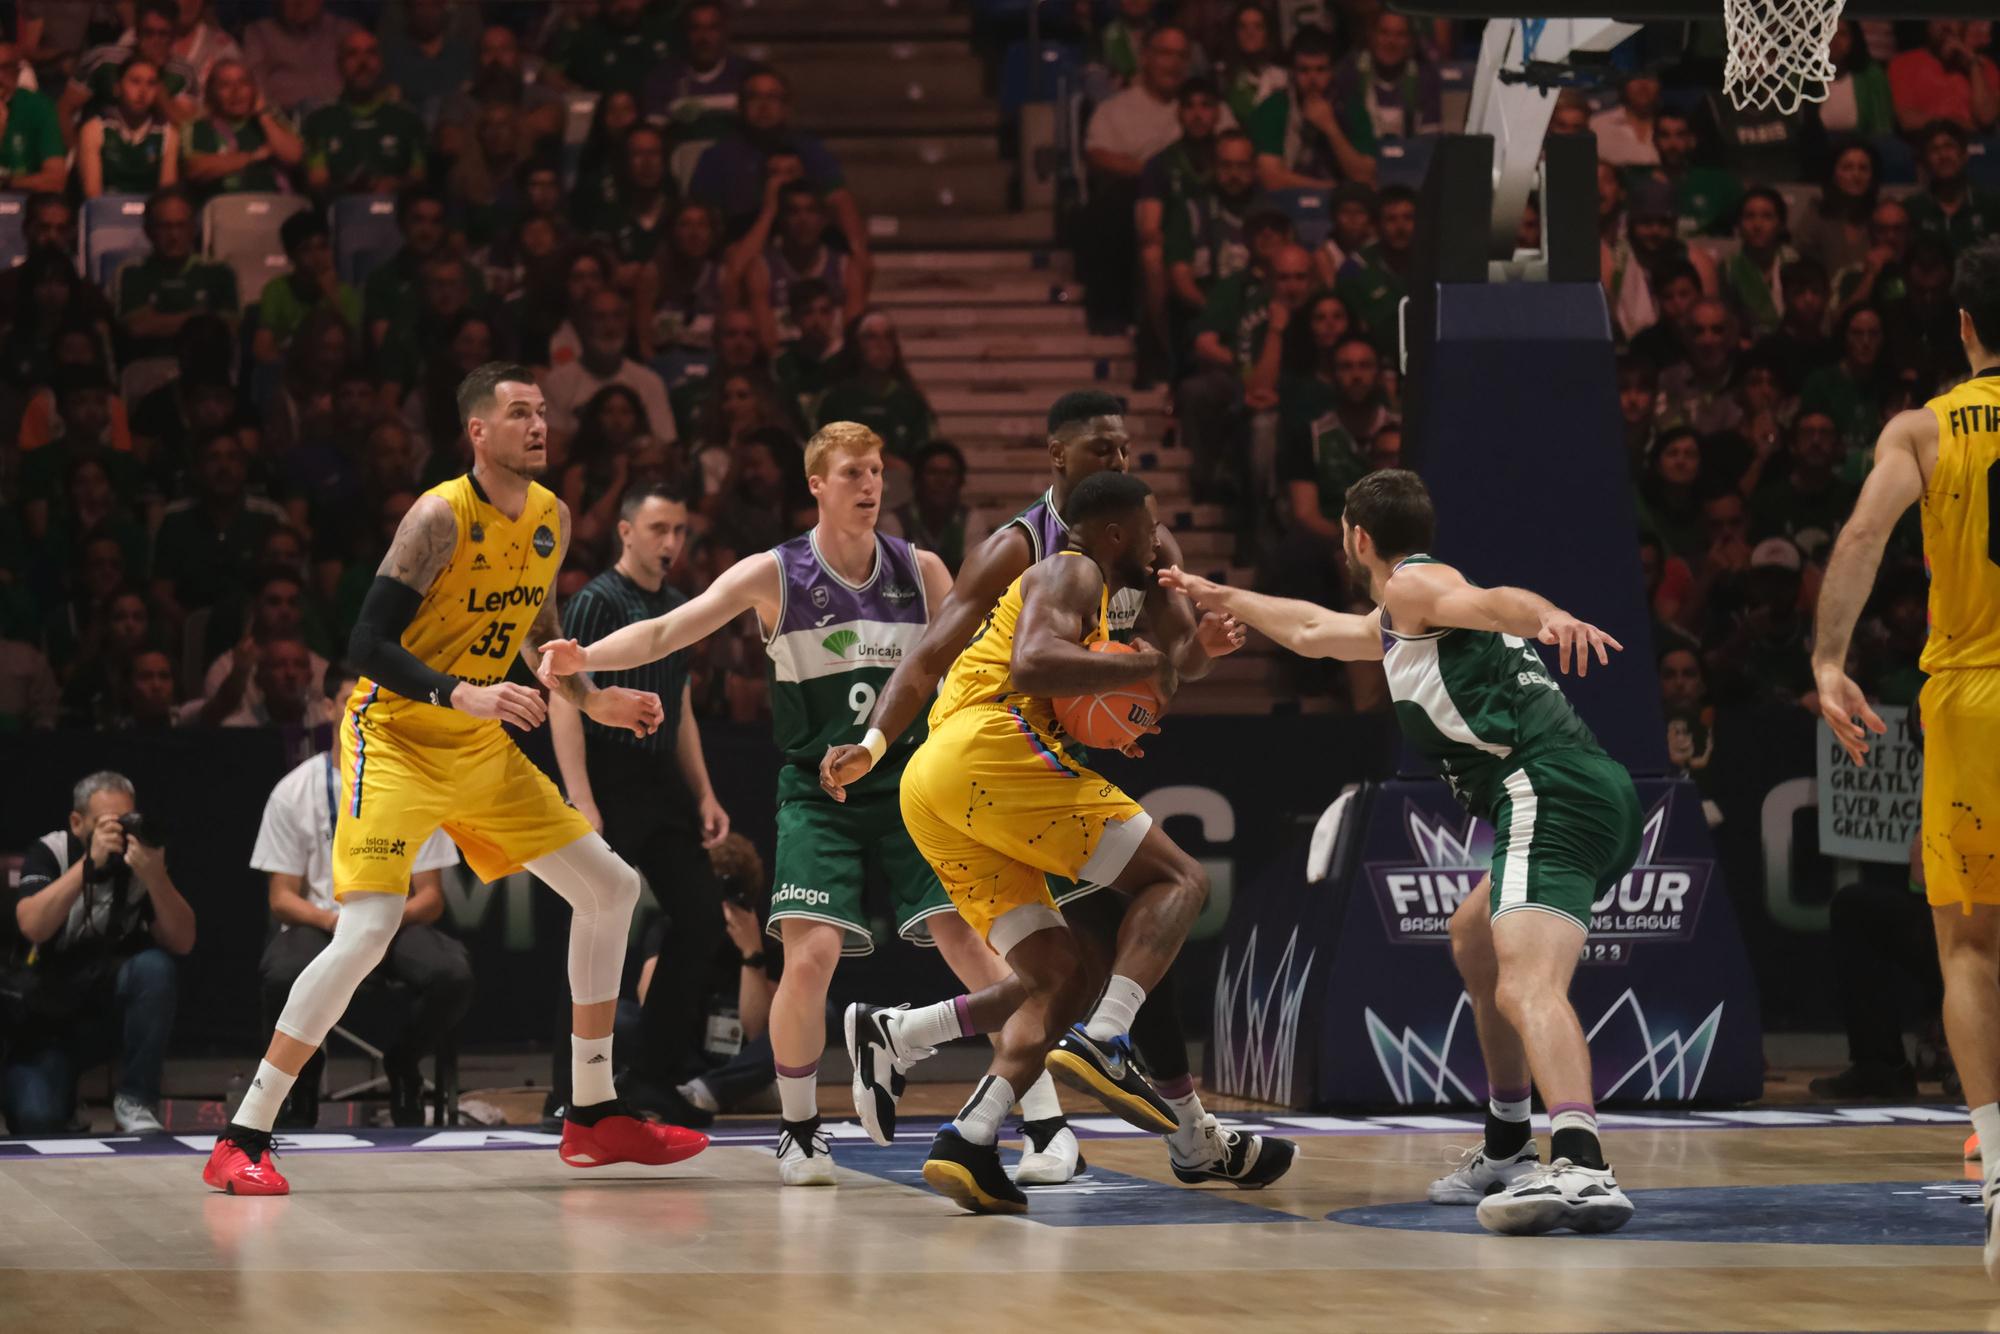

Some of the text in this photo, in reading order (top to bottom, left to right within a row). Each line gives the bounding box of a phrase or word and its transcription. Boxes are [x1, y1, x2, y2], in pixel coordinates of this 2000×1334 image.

[470, 620, 516, 660] 35
[858, 643, 902, 659] Unicaja
[1893, 745, 1919, 771] TO
[1831, 769, 1920, 793] GREATLY
[1832, 794, 1880, 819] EVER
[1833, 817, 1910, 843] GREATLY
[1386, 872, 1691, 914] FIN OUR
[1615, 914, 1682, 930] LEAGUE
[1579, 944, 1622, 961] 023
